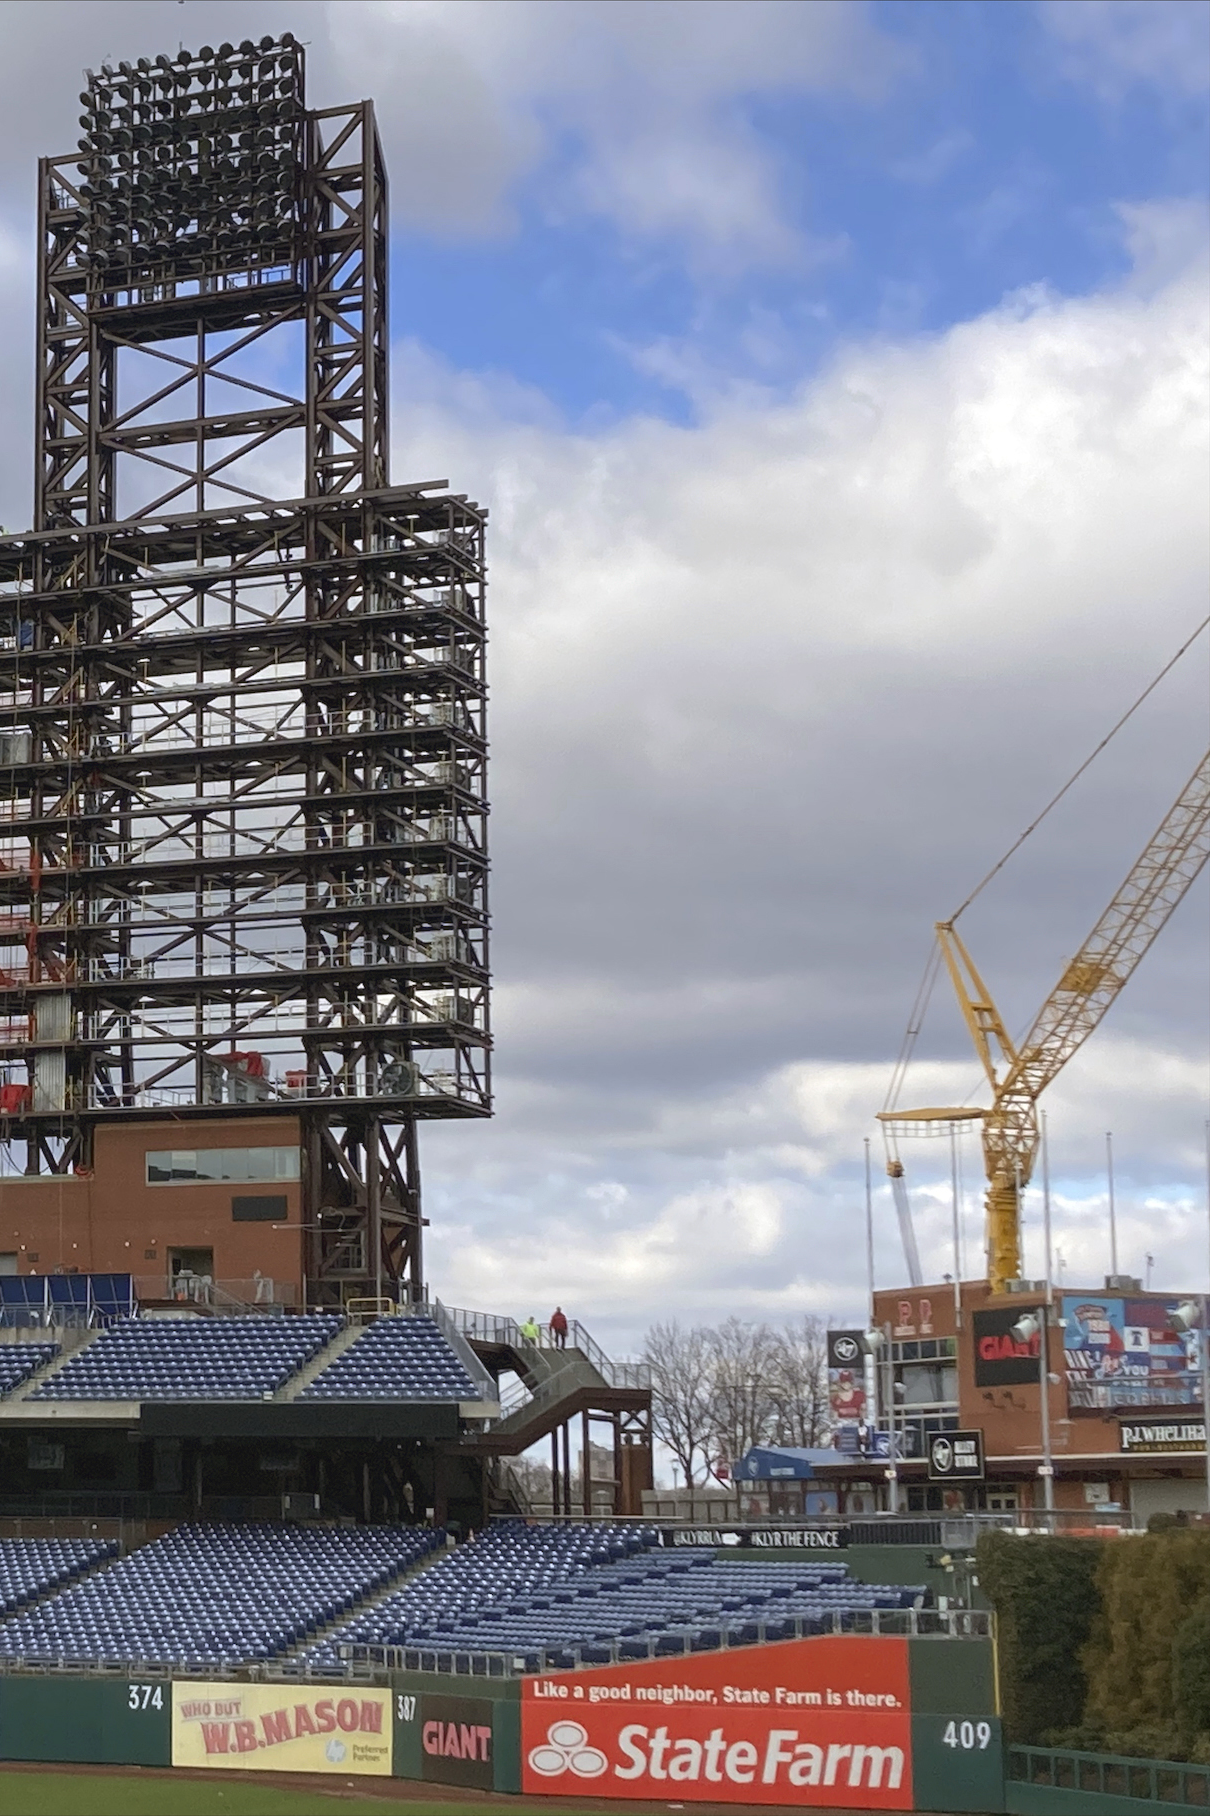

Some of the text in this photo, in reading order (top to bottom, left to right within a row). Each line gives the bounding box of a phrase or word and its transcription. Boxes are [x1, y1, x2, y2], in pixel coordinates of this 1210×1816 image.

[128, 1685, 164, 1711] 374
[533, 1681, 902, 1708] Like a good neighbor, State Farm is there.
[180, 1701, 241, 1719] WHO BUT
[397, 1695, 416, 1721] 387
[422, 1720, 493, 1762] GIANT
[943, 1720, 991, 1750] 409
